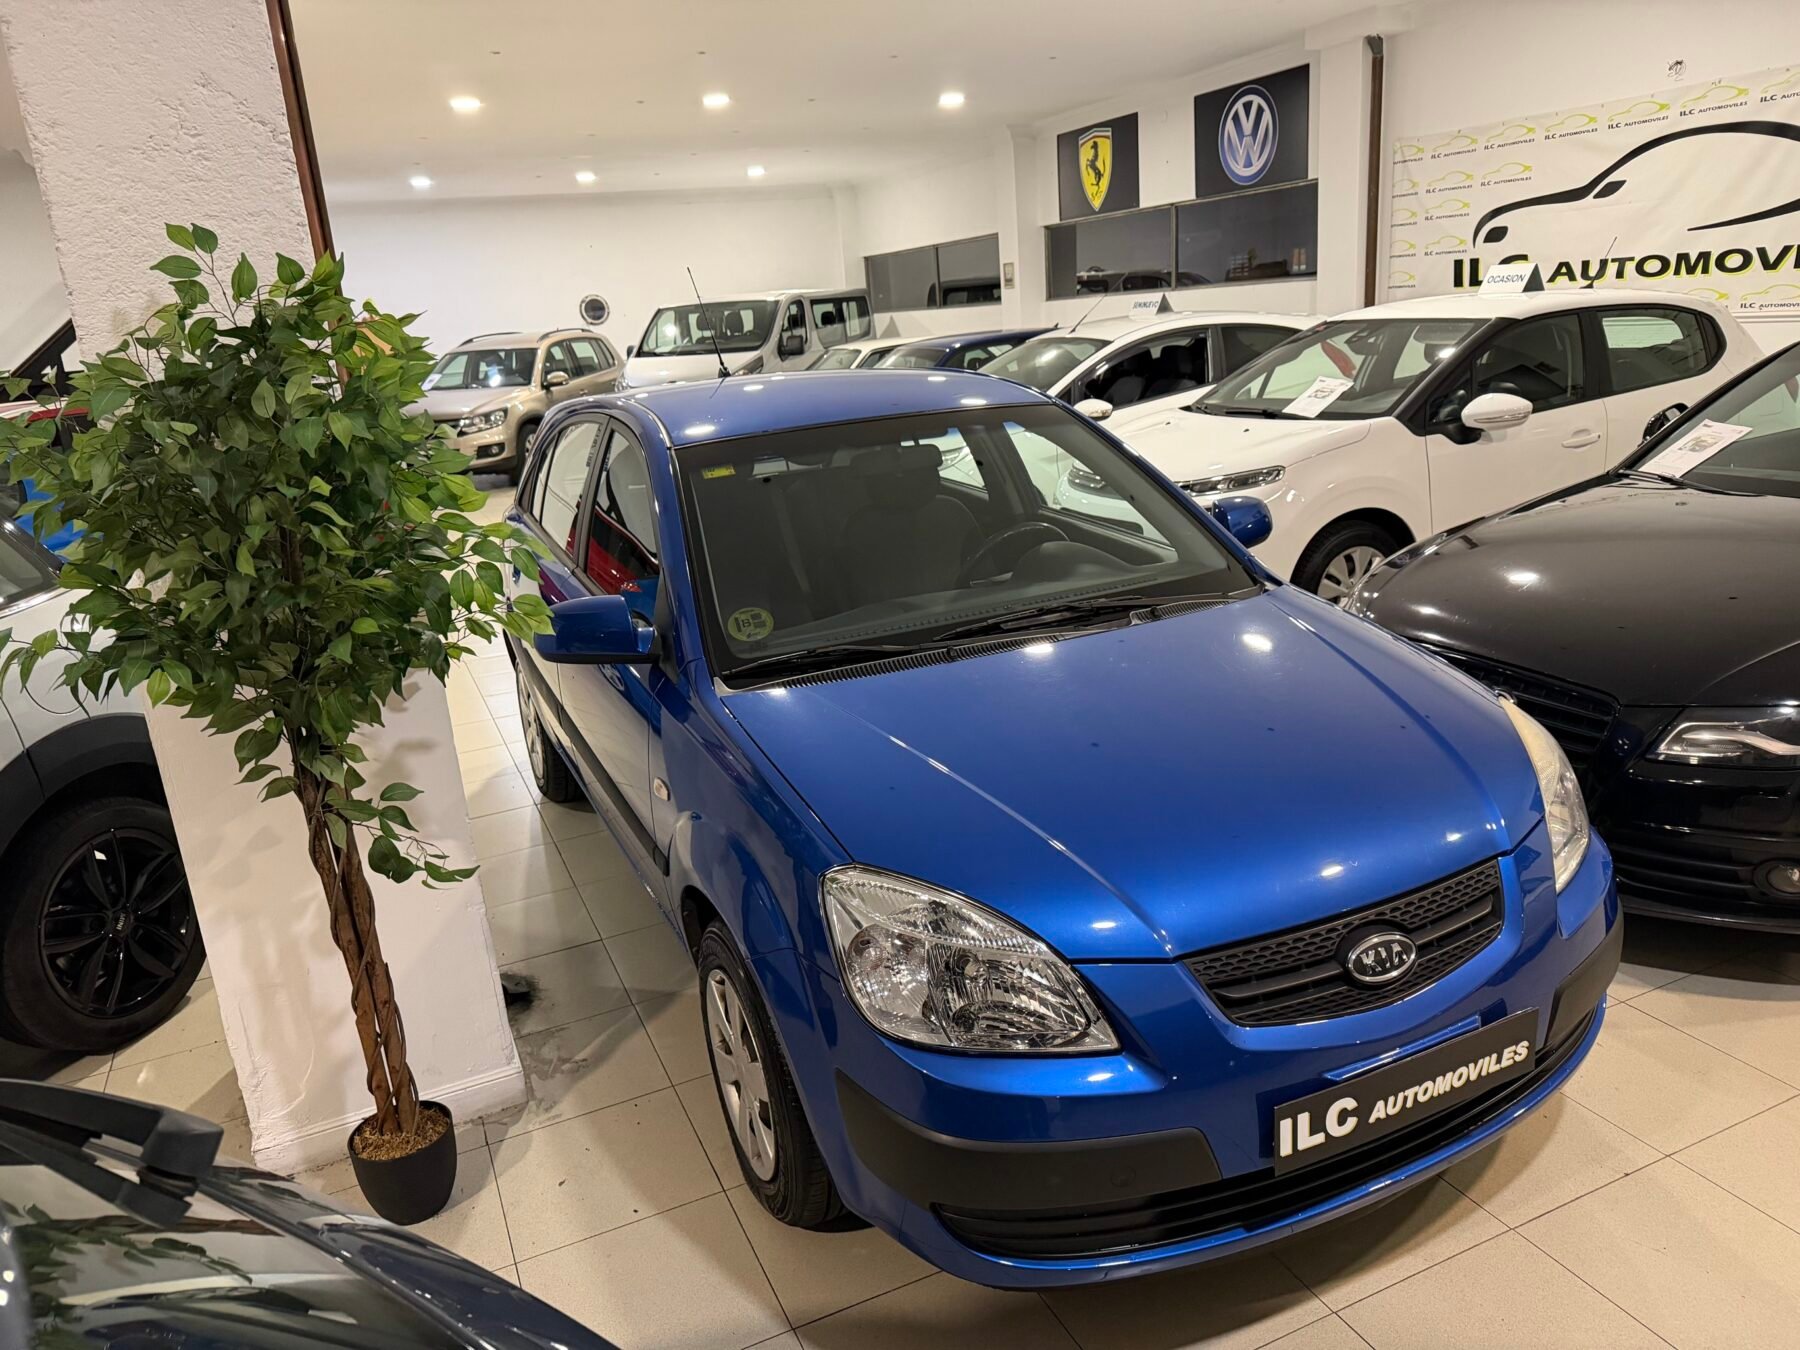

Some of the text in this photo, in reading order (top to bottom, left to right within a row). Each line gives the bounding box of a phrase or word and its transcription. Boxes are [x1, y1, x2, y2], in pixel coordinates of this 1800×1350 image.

[1760, 94, 1777, 103] ILC
[1680, 101, 1748, 117] ILC AUTOMOVILES
[1608, 115, 1669, 130] ILC AUTOMOVILES
[1544, 128, 1598, 141] ILC AUTOMOVILES
[1497, 138, 1535, 148] AUTOMOVILES
[1431, 152, 1442, 160] ILC
[1493, 176, 1532, 185] AUTOMOVILES
[1438, 184, 1473, 193] AUTOMOVILES
[1487, 273, 1526, 284] OCASION
[1359, 941, 1409, 975] KIA
[1279, 1040, 1530, 1158] ILC AUTOMOVILES
